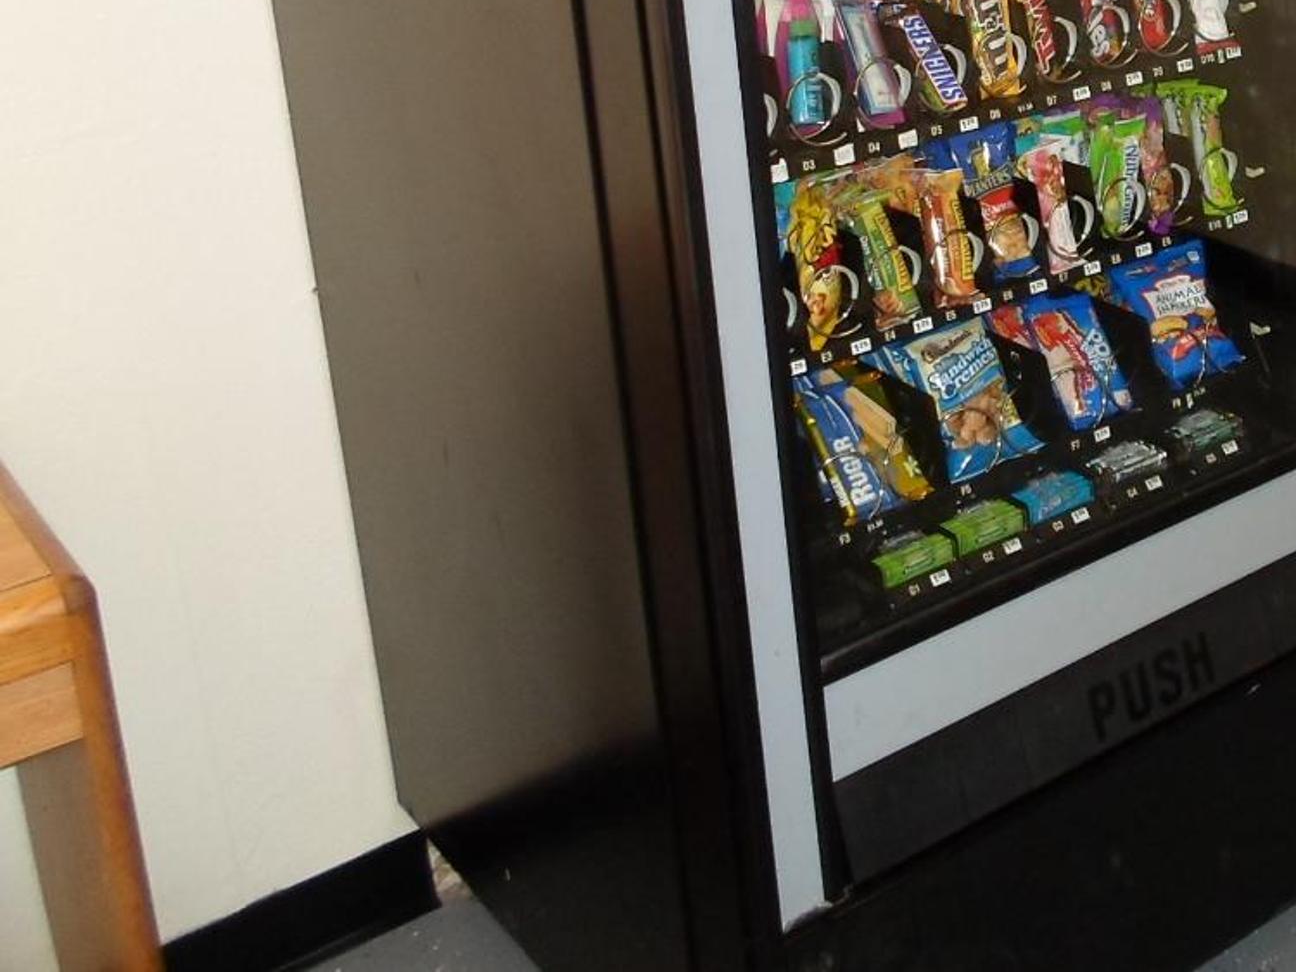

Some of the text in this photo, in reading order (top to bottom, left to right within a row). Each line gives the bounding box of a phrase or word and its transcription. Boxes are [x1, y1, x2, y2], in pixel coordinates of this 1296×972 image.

[903, 15, 965, 102] SNICKERS
[930, 336, 993, 389] Sandwich
[1087, 630, 1215, 740] PUSH
